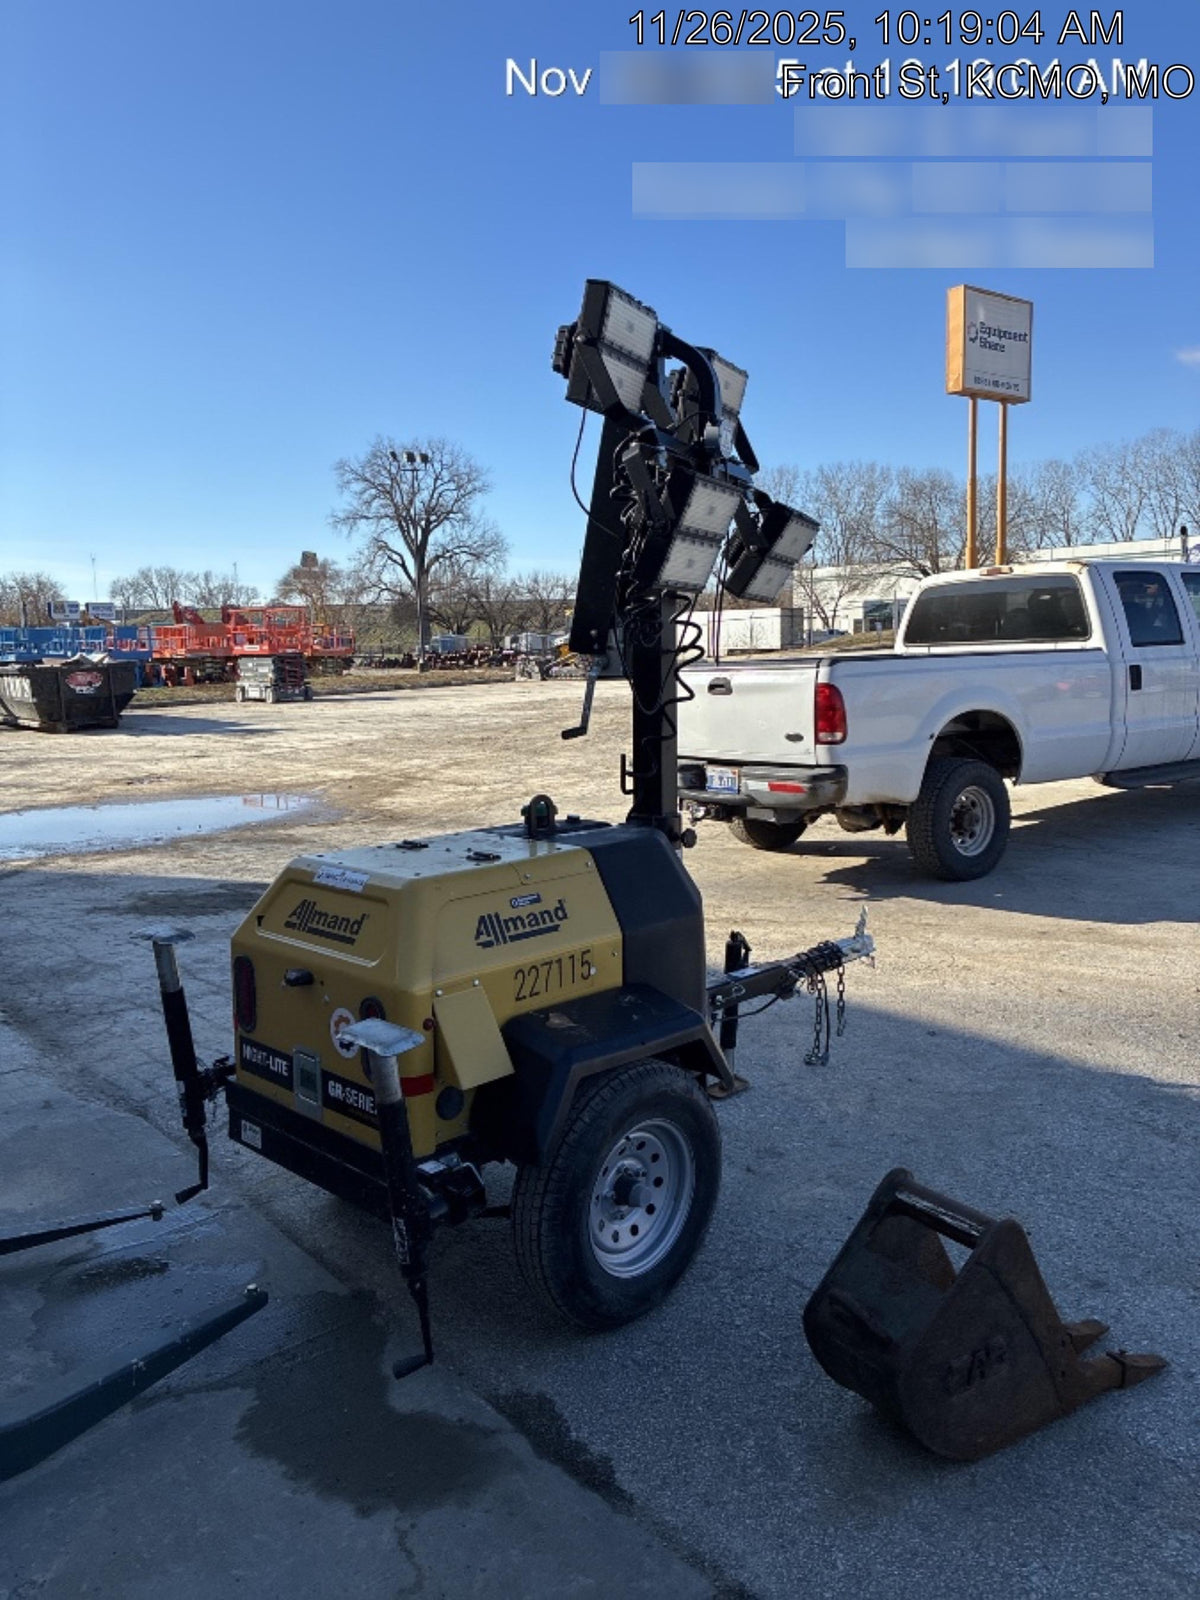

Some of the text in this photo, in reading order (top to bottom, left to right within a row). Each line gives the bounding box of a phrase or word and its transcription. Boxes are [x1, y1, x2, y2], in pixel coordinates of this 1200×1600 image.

[286, 898, 369, 938] Allmand
[474, 898, 568, 946] Allmand
[513, 948, 592, 1002] 227115
[327, 1080, 378, 1115] GR-SERIE
